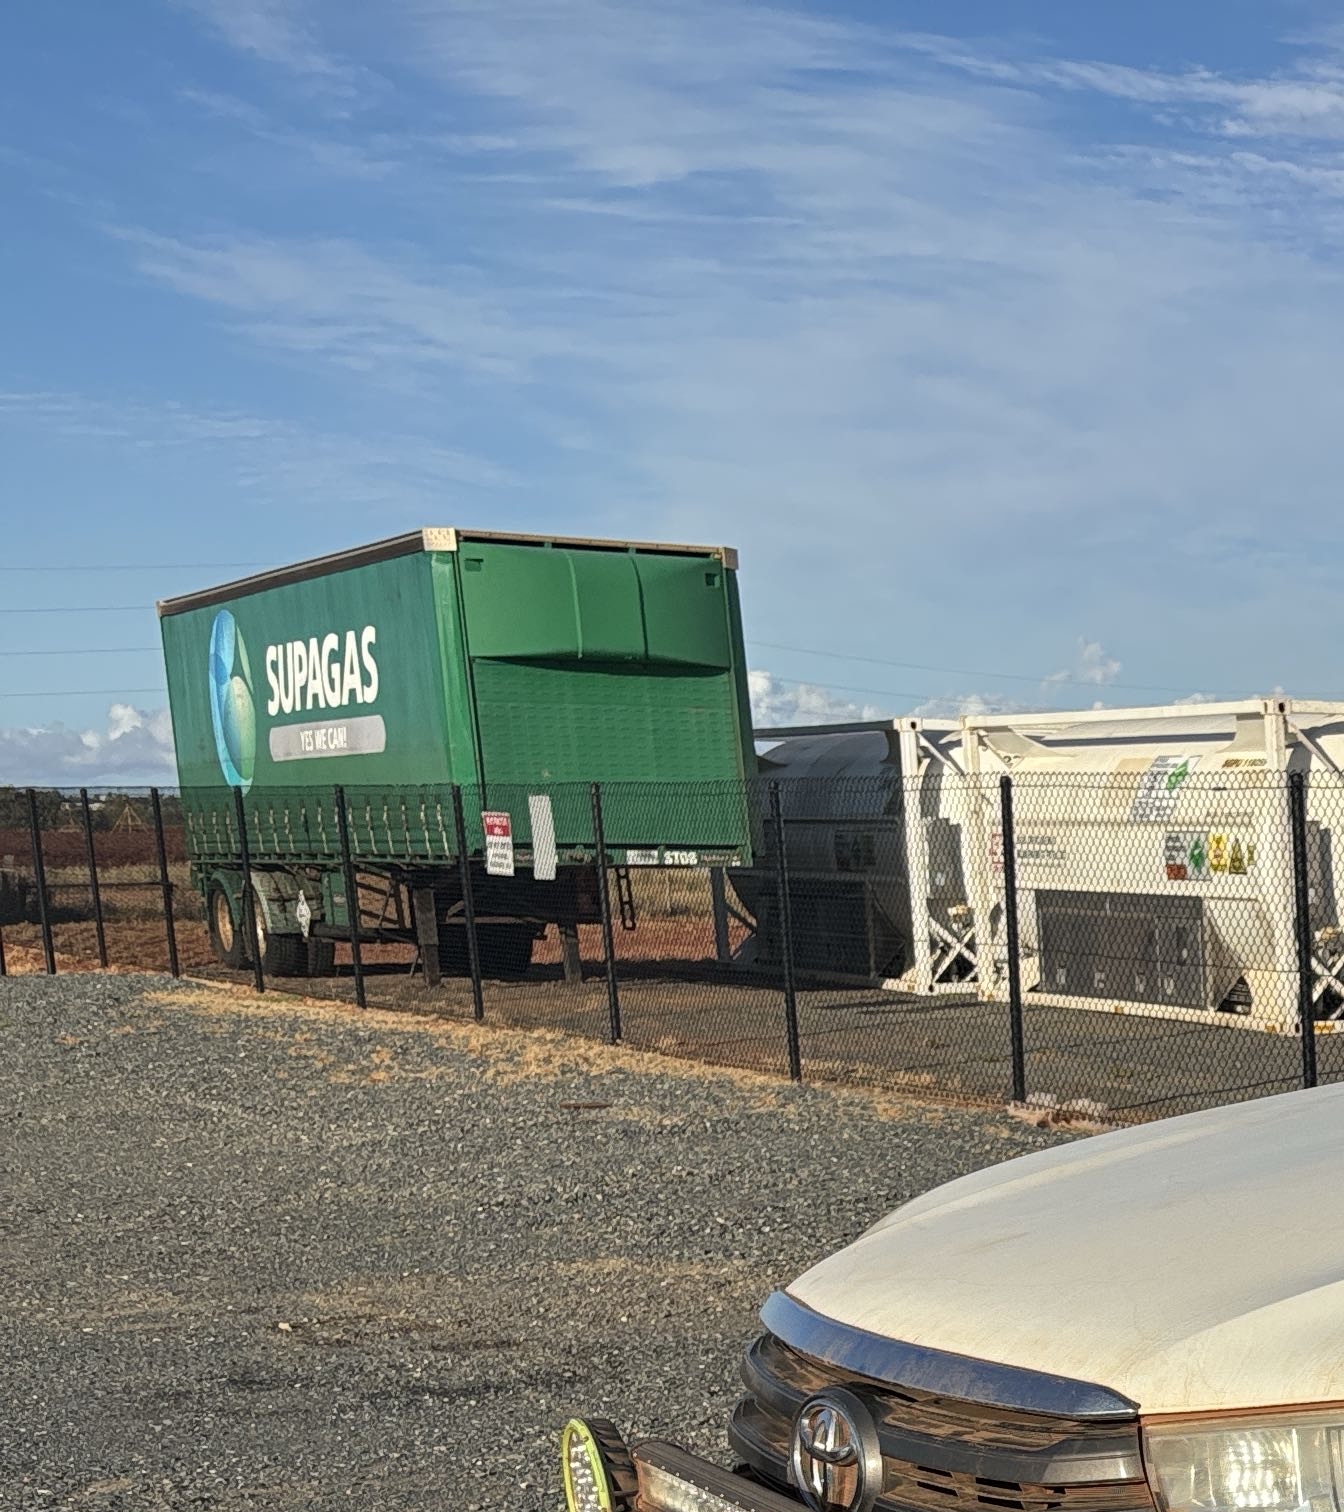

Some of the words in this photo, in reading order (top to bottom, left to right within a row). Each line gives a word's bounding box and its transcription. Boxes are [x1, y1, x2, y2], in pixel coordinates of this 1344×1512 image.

[266, 625, 379, 716] SUPAGAS
[300, 730, 313, 751] YES
[315, 729, 327, 750] WE
[328, 726, 347, 749] CAN!
